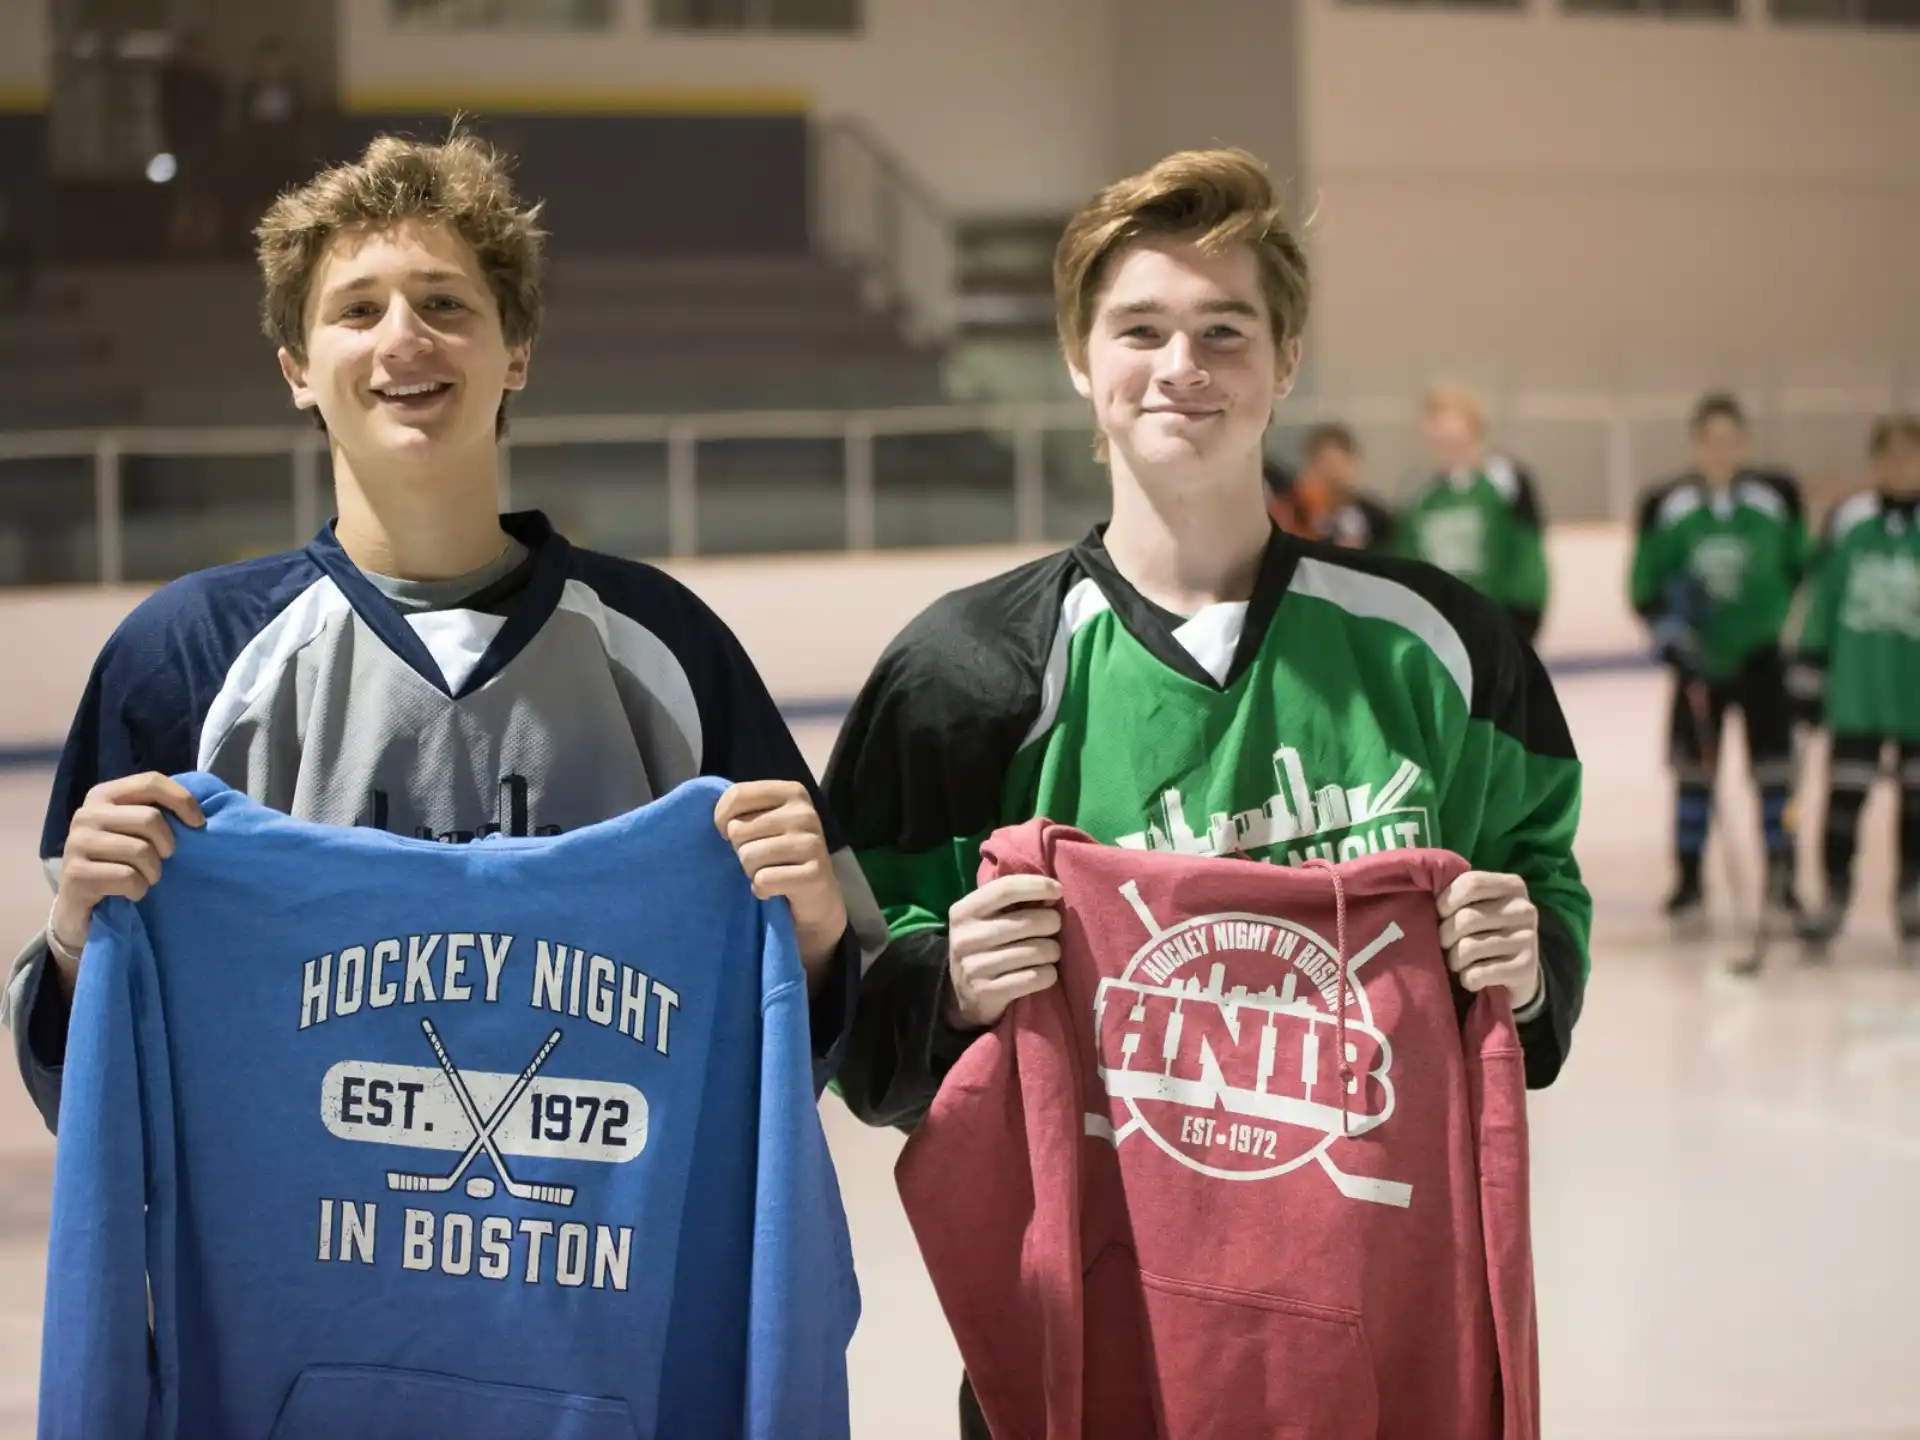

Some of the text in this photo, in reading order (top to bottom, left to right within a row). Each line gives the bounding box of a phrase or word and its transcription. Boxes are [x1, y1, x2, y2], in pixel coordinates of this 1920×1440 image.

[298, 932, 680, 1057] HOCKEY NIGHT
[1141, 926, 1210, 985] HOCKEY
[1212, 922, 1273, 952] NIGHT
[1271, 929, 1299, 960] IN
[1097, 982, 1391, 1122] HNIB
[341, 1076, 629, 1147] EST. 1972
[316, 1198, 634, 1292] IN BOSTON
